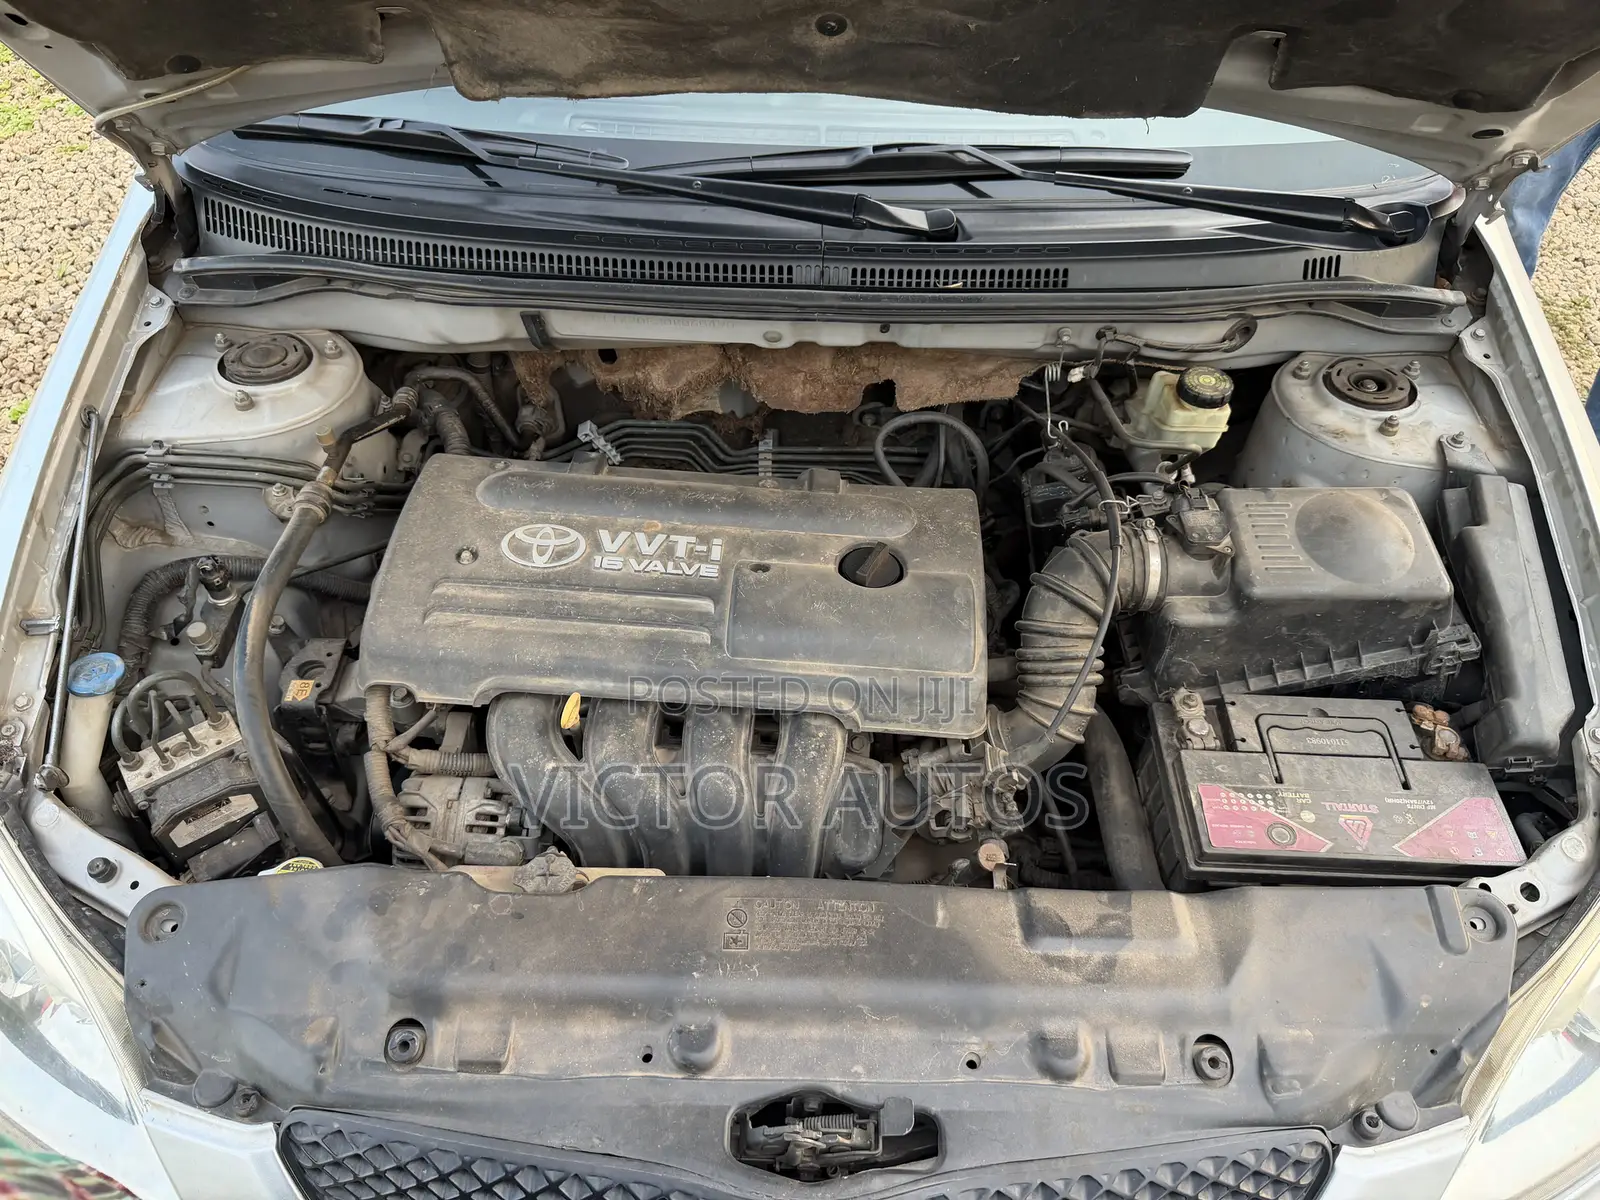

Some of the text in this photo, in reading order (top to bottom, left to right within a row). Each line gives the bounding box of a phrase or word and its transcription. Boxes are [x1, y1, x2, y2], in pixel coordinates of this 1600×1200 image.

[598, 529, 723, 562] VVT-i
[593, 556, 720, 579] 16 VALVE
[1320, 801, 1380, 813] STARTALL
